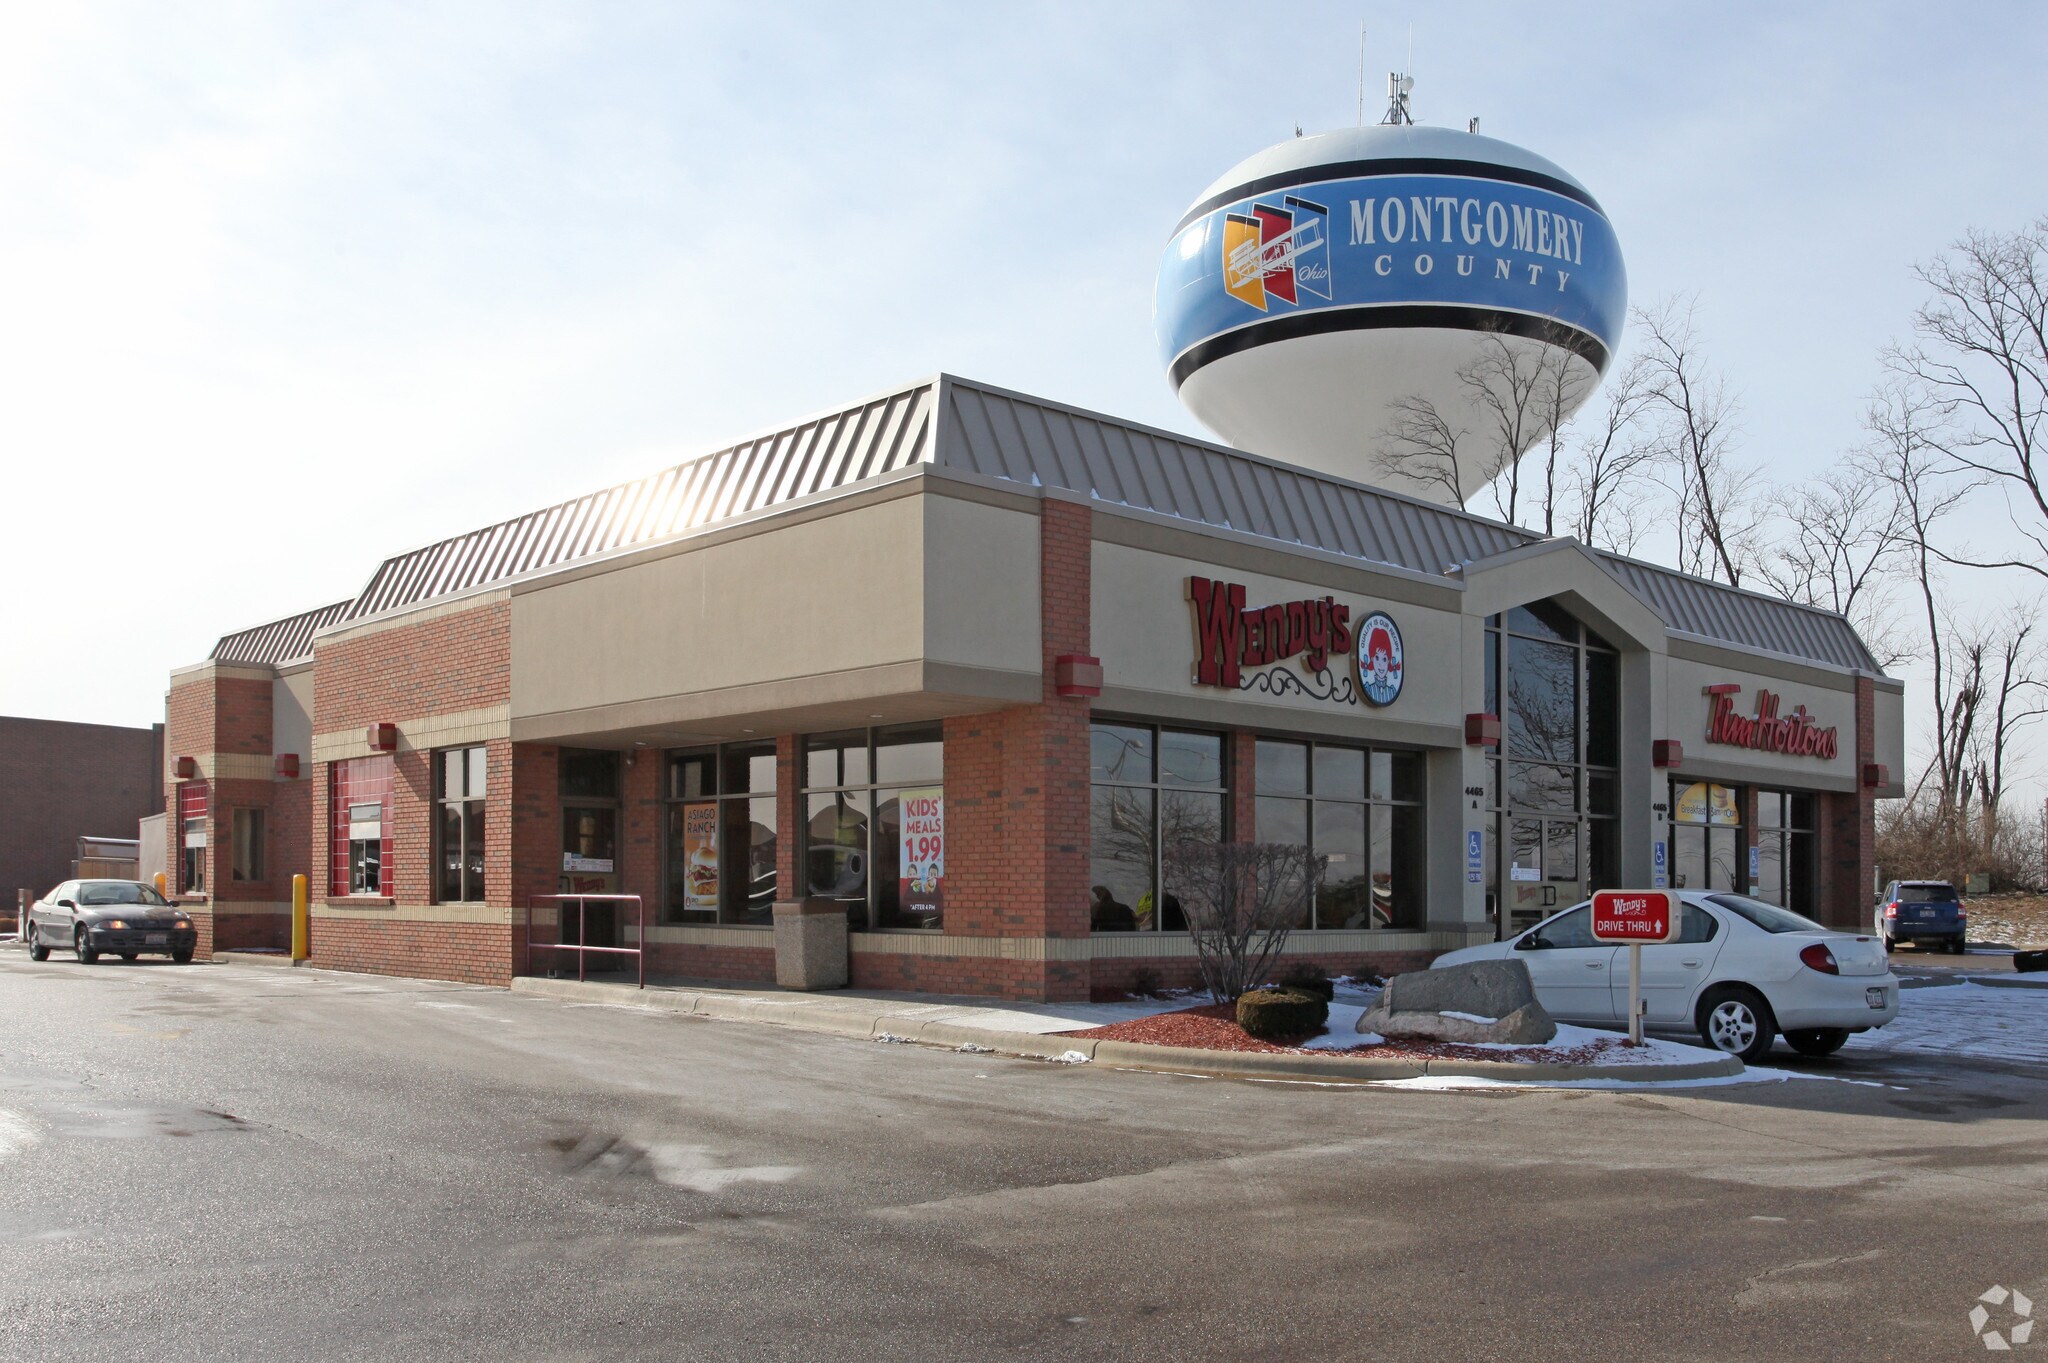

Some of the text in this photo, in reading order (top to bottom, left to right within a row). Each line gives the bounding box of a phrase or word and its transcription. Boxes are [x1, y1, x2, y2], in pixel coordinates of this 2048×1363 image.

[1349, 195, 1584, 265] MONTGOMERY
[1298, 261, 1329, 281] Ohio
[1374, 254, 1571, 292] COUNTY
[1189, 575, 1352, 689] Wendy's
[1361, 621, 1373, 648] QUALITY
[1380, 619, 1389, 628] OUR
[1389, 628, 1400, 652] RECIPE
[1702, 683, 1838, 760] Tim Hortons
[1465, 786, 1484, 797] 4465
[1472, 800, 1478, 809] A
[1681, 804, 1706, 815] Breakfast
[688, 808, 716, 820] ASIAGO
[688, 821, 716, 833] RANCH
[906, 818, 941, 834] MEALS
[1612, 898, 1646, 915] Wendy's
[1597, 920, 1652, 932] DRIVE THRU
